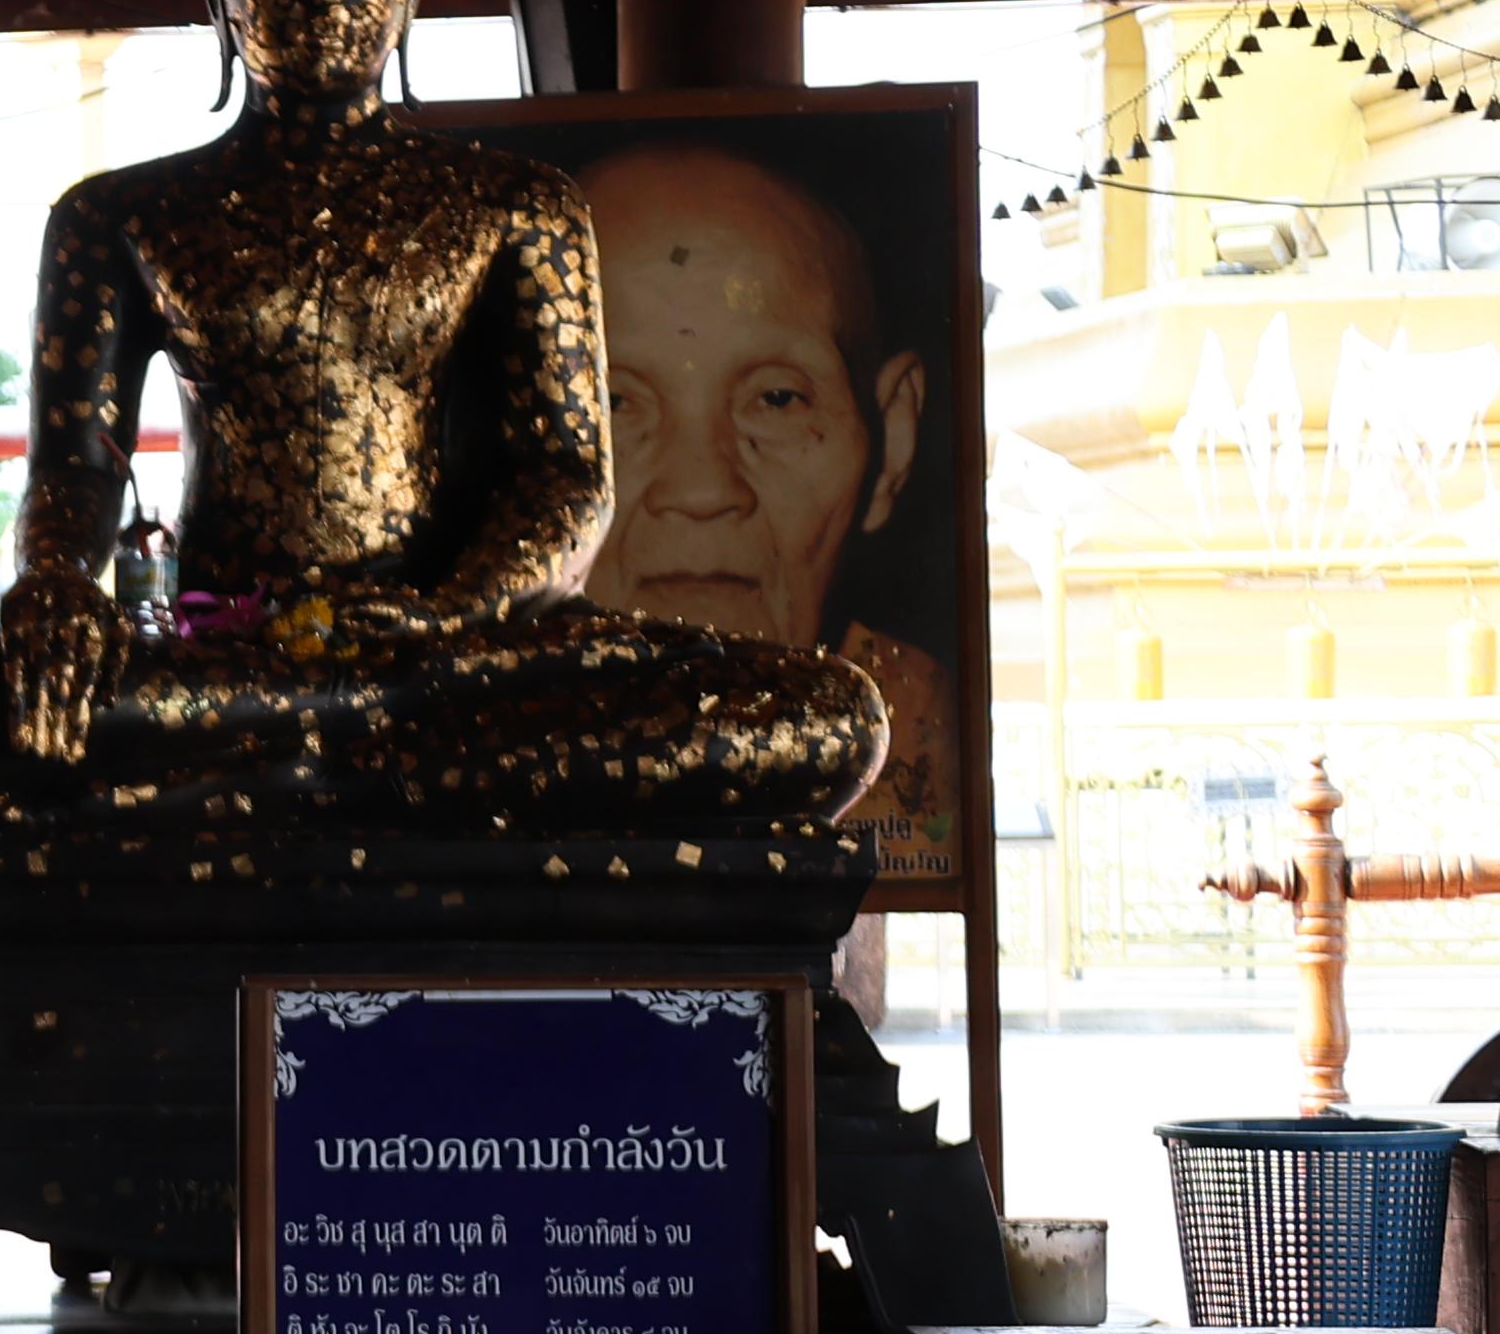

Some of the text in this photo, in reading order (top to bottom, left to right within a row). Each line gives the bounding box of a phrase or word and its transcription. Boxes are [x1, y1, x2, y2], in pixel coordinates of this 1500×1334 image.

[314, 1123, 729, 1173] บทสวดตามกำลังวัน
[284, 1213, 691, 1254] อะ วิช สุ นุส สา นุต ติ วันอาทิตย์ ๖ จบ
[283, 1264, 694, 1298] อิ ระ ชา คะ ตะ ระ สา วันจันทร์ ๑๕ จบ
